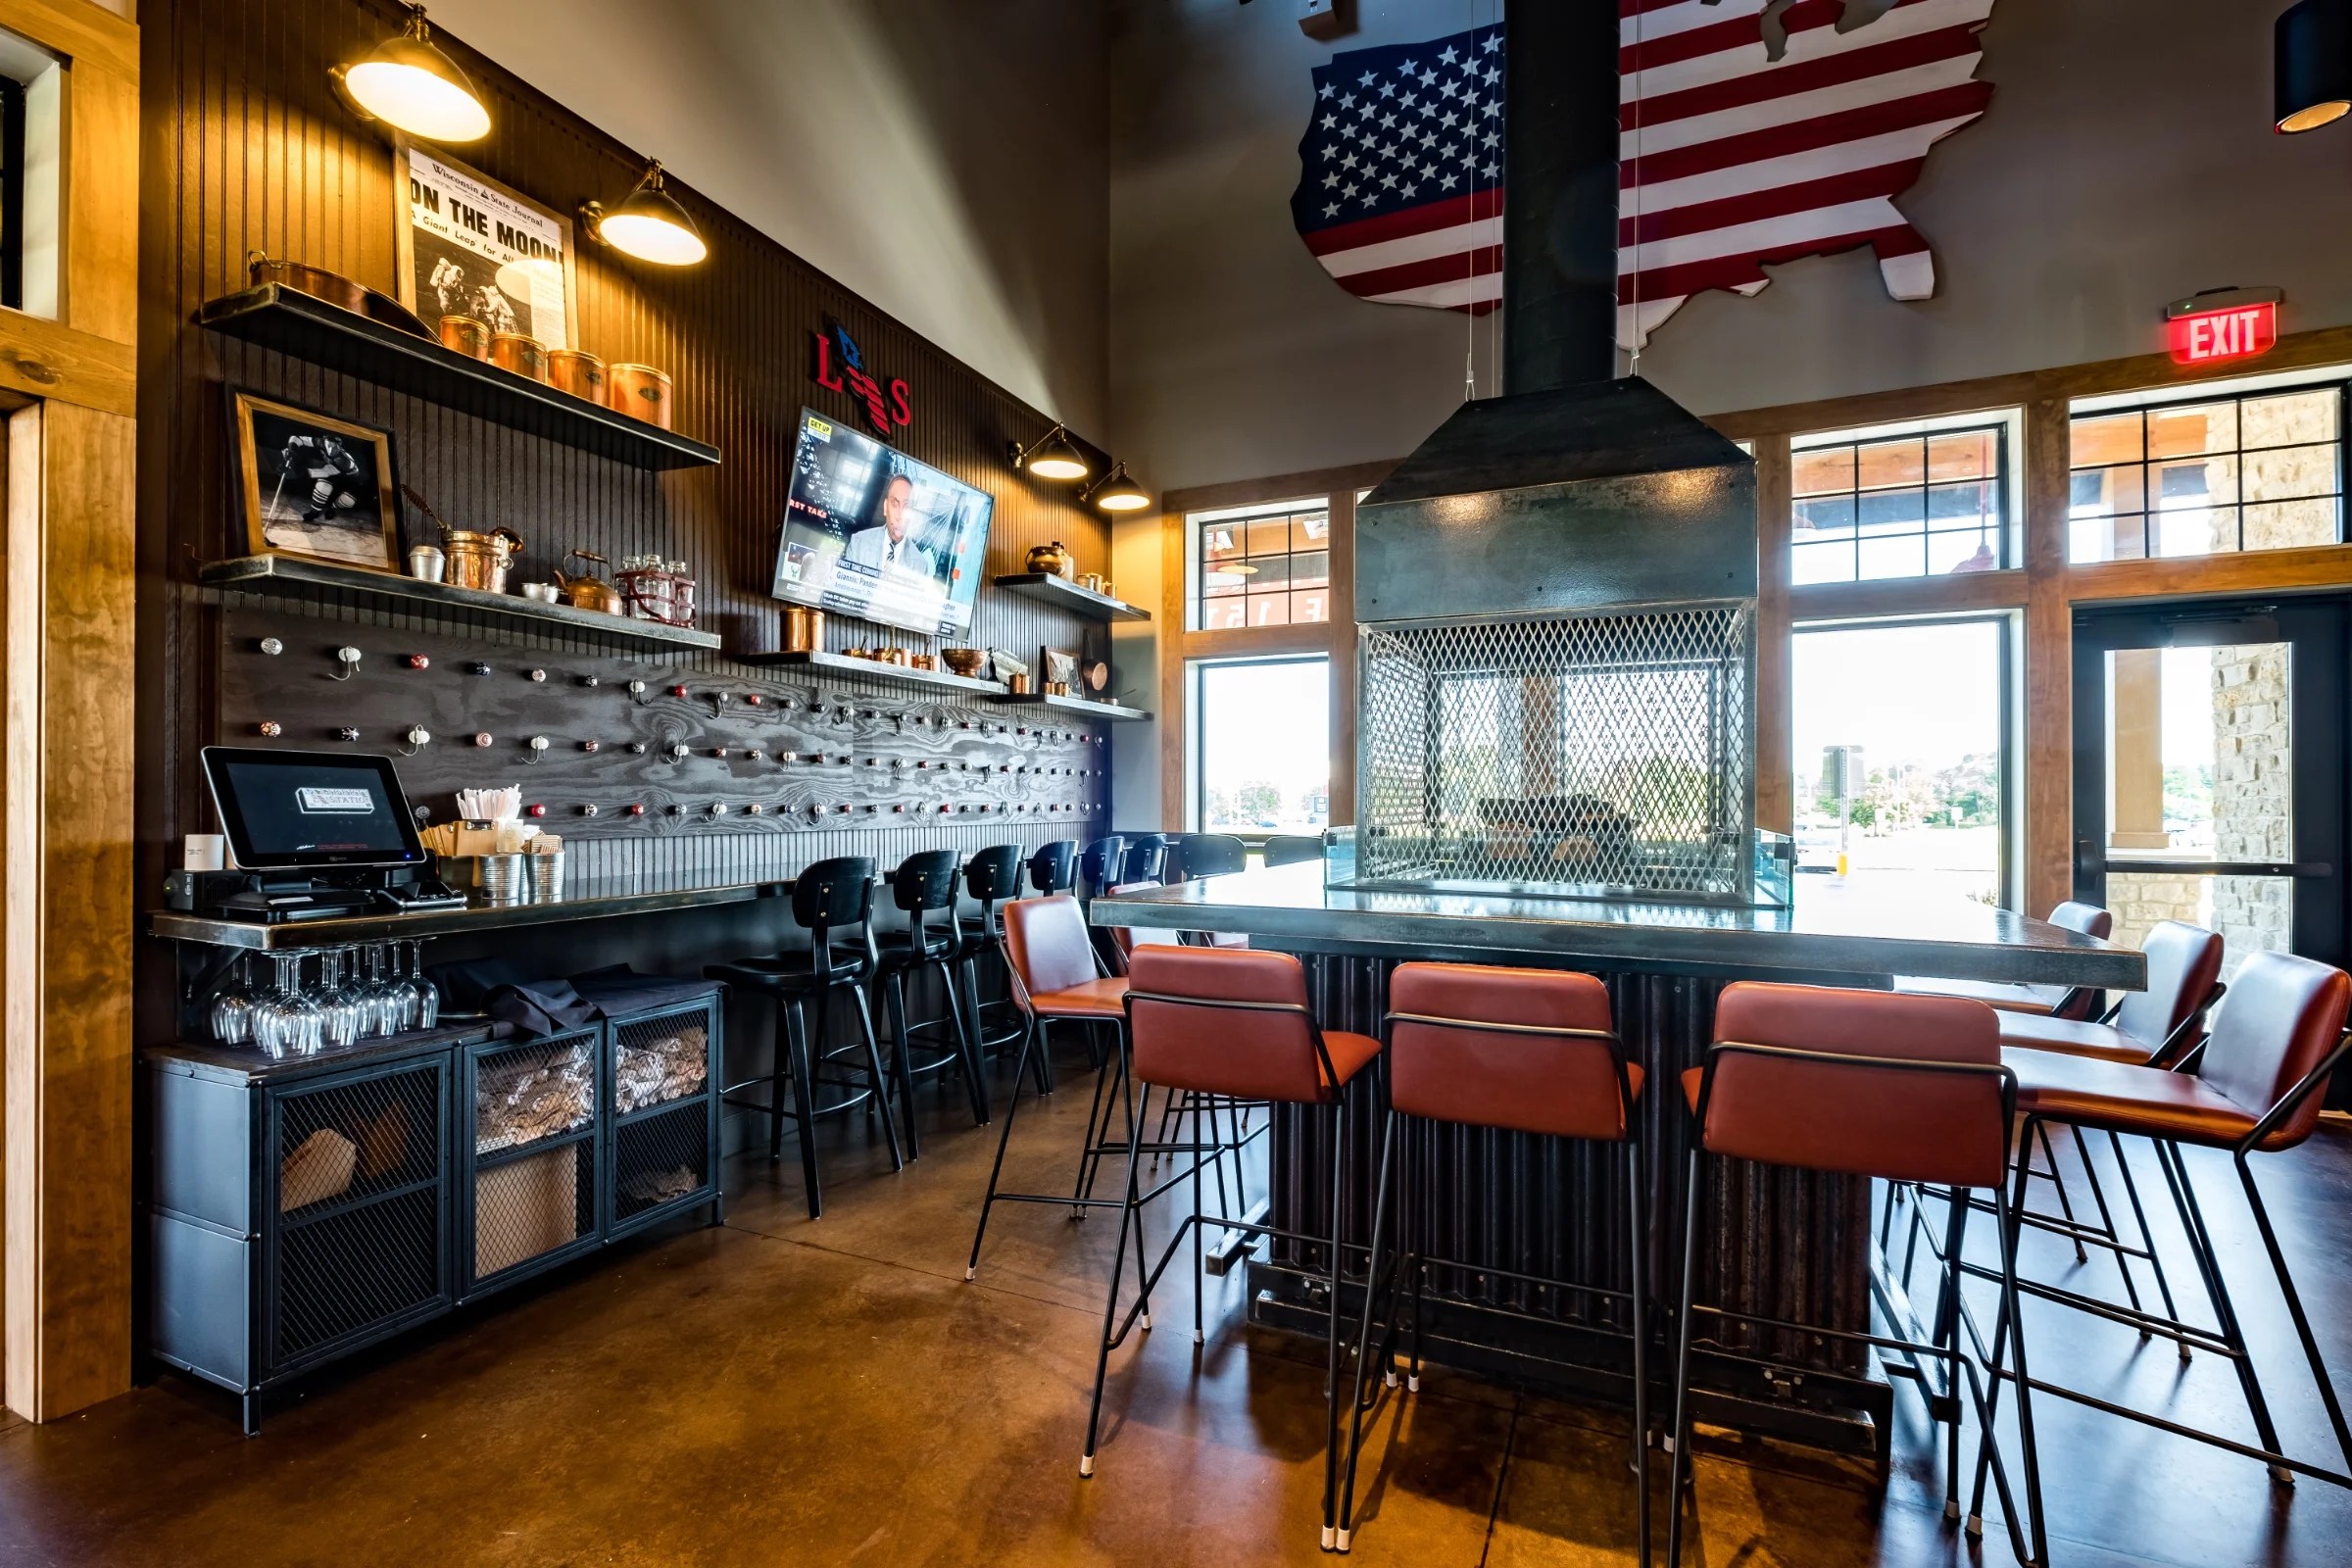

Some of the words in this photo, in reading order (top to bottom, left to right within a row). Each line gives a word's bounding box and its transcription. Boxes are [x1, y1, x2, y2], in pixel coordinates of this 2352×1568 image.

[410, 177, 440, 215] ON
[449, 197, 489, 238] THE
[432, 163, 479, 194] Wisconsin
[490, 193, 511, 210] State
[513, 206, 543, 227] Journal
[422, 216, 449, 234] Giant
[455, 230, 476, 248] Leap
[483, 244, 497, 256] for
[2189, 310, 2260, 360] EXIT
[809, 419, 822, 429] GET
[807, 506, 828, 518] TAKE
[838, 559, 851, 569] FIRST
